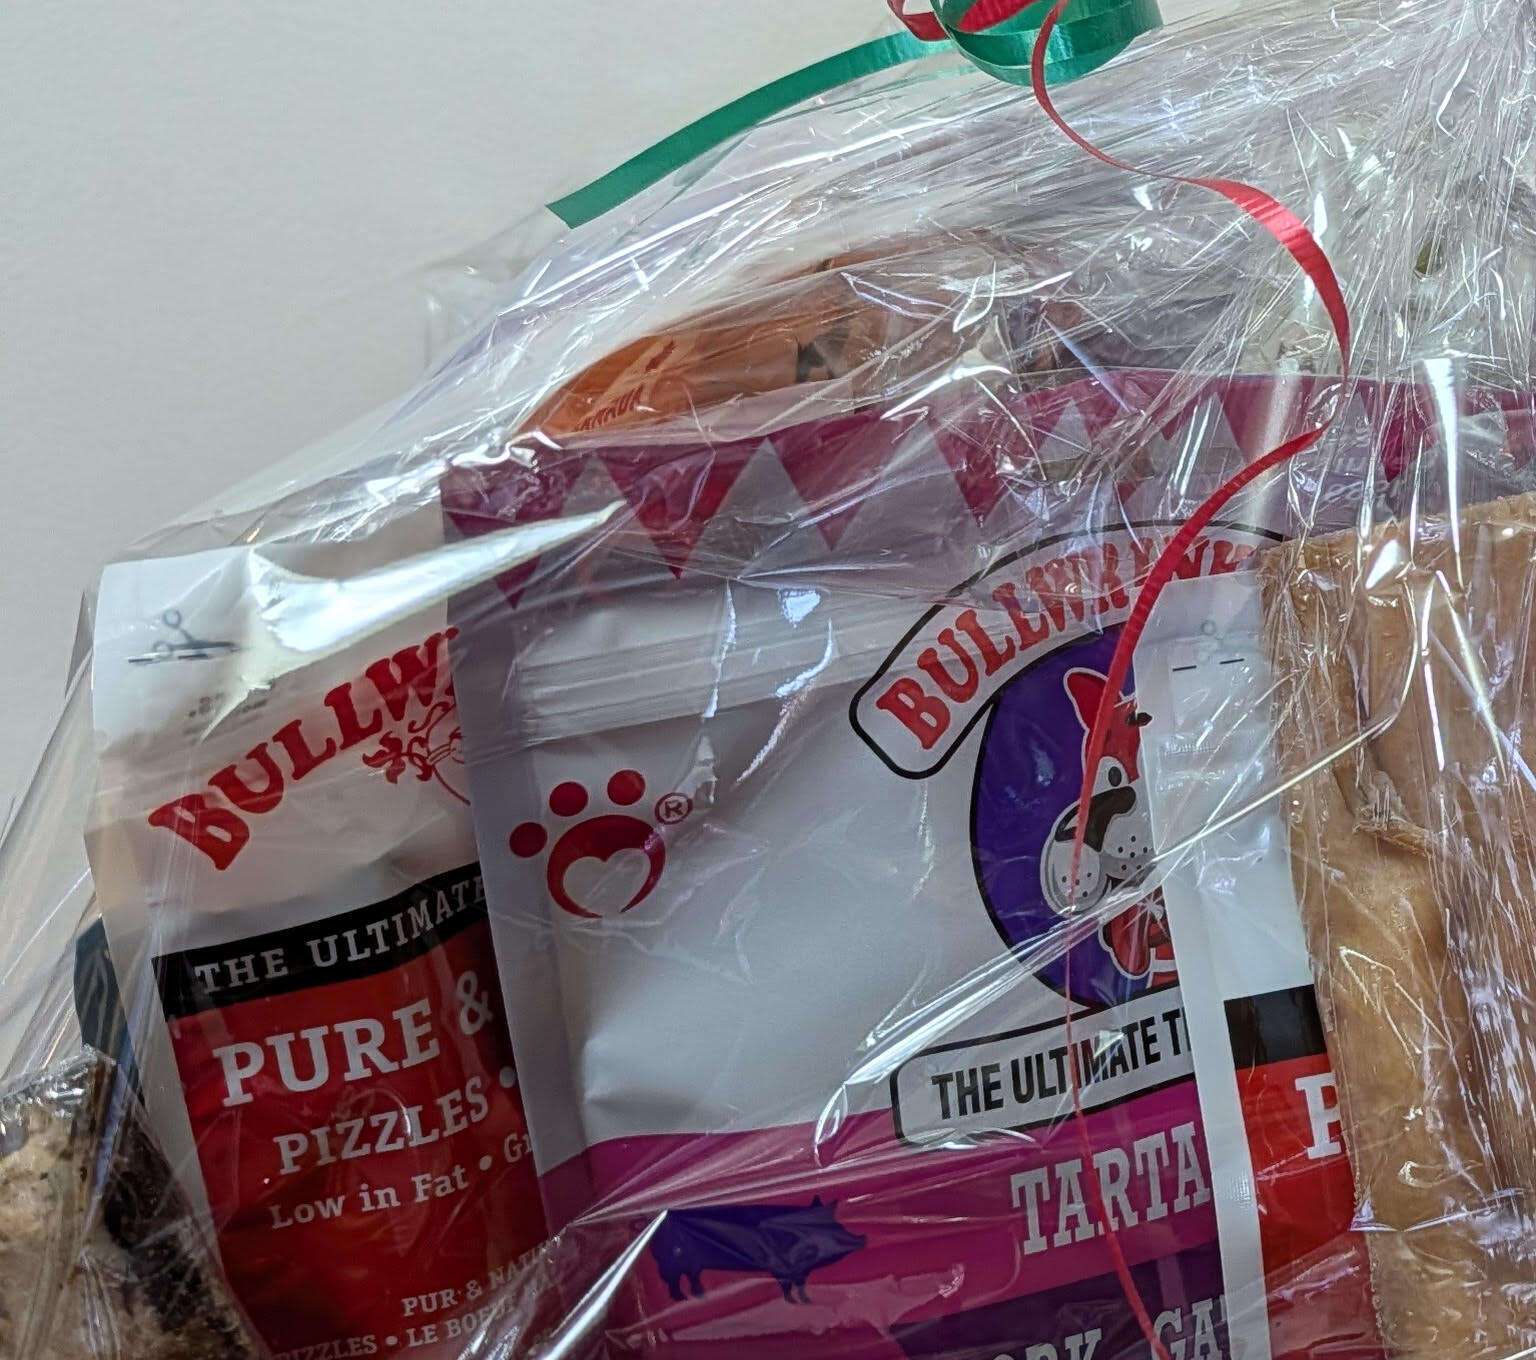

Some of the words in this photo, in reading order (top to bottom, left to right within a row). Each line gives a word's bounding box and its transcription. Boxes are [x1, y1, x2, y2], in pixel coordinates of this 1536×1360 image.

[147, 626, 459, 872] BULLW
[195, 947, 289, 995] THE
[212, 997, 441, 1108] PURE
[456, 969, 494, 1036] &
[930, 1057, 1005, 1120] THE
[1010, 1014, 1162, 1105] ULTIMATE
[1162, 1006, 1195, 1056] T
[273, 1075, 489, 1177] PIZZLES
[268, 1193, 347, 1231] Low
[358, 1182, 401, 1213] in
[410, 1163, 470, 1204] Fat
[401, 1287, 459, 1318] PUR
[464, 1278, 484, 1302] &
[405, 1323, 440, 1349] LE
